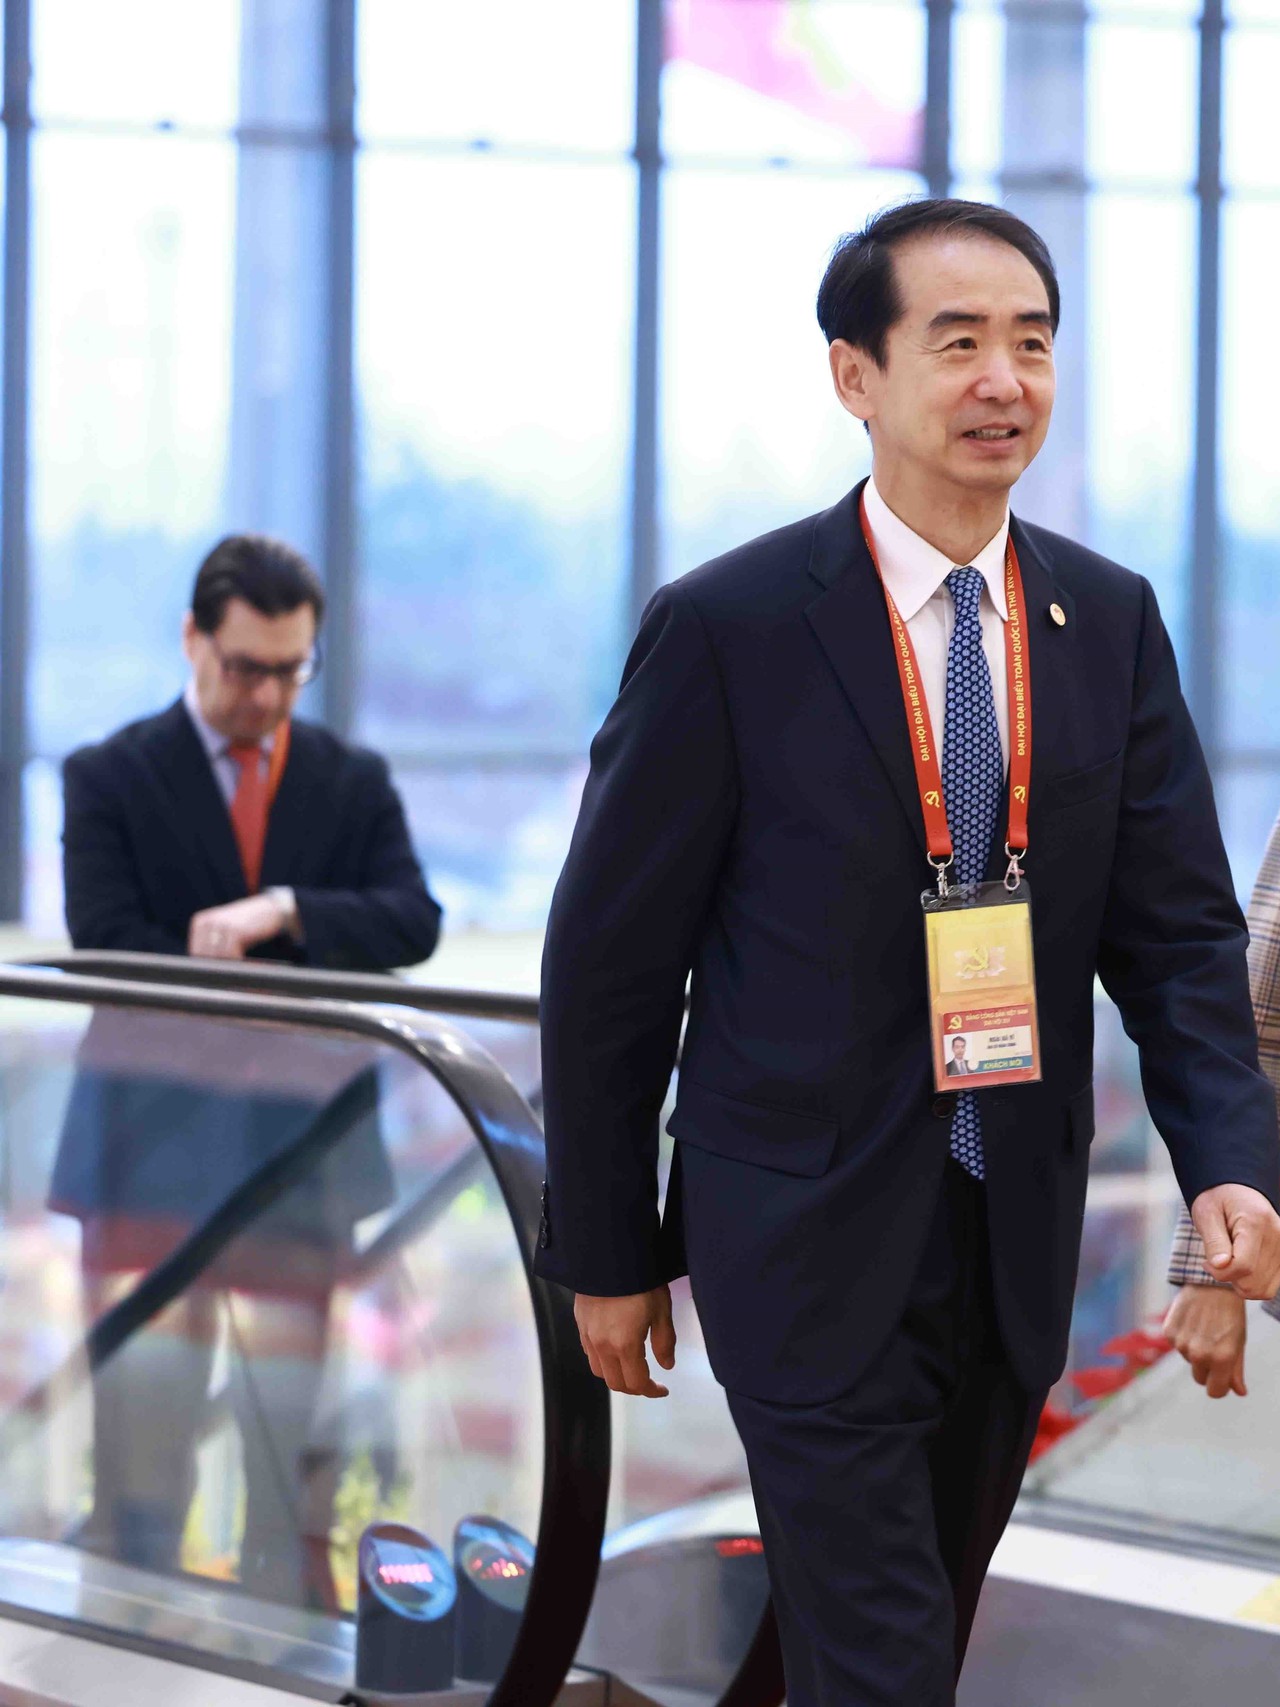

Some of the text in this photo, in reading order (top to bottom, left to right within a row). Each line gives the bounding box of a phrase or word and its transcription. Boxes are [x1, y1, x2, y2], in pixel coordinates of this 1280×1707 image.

[1007, 576, 1015, 590] XIV
[1007, 591, 1017, 608] THỨ
[893, 612, 903, 630] LẦN
[1008, 609, 1019, 626] LẦN
[897, 631, 910, 658] QUỐC
[1011, 627, 1022, 653] QUỐC
[904, 659, 916, 684] TOÀN
[1013, 654, 1023, 679] TOÀN
[908, 685, 920, 706] BIỂU
[1013, 681, 1024, 701] BIỂU
[913, 707, 924, 724] ĐẠI
[1016, 703, 1026, 719] ĐẠI
[916, 726, 927, 743] HỘI
[1016, 720, 1027, 737] HỘI
[920, 745, 930, 761] ĐẠI
[1017, 740, 1027, 756] ĐẠI
